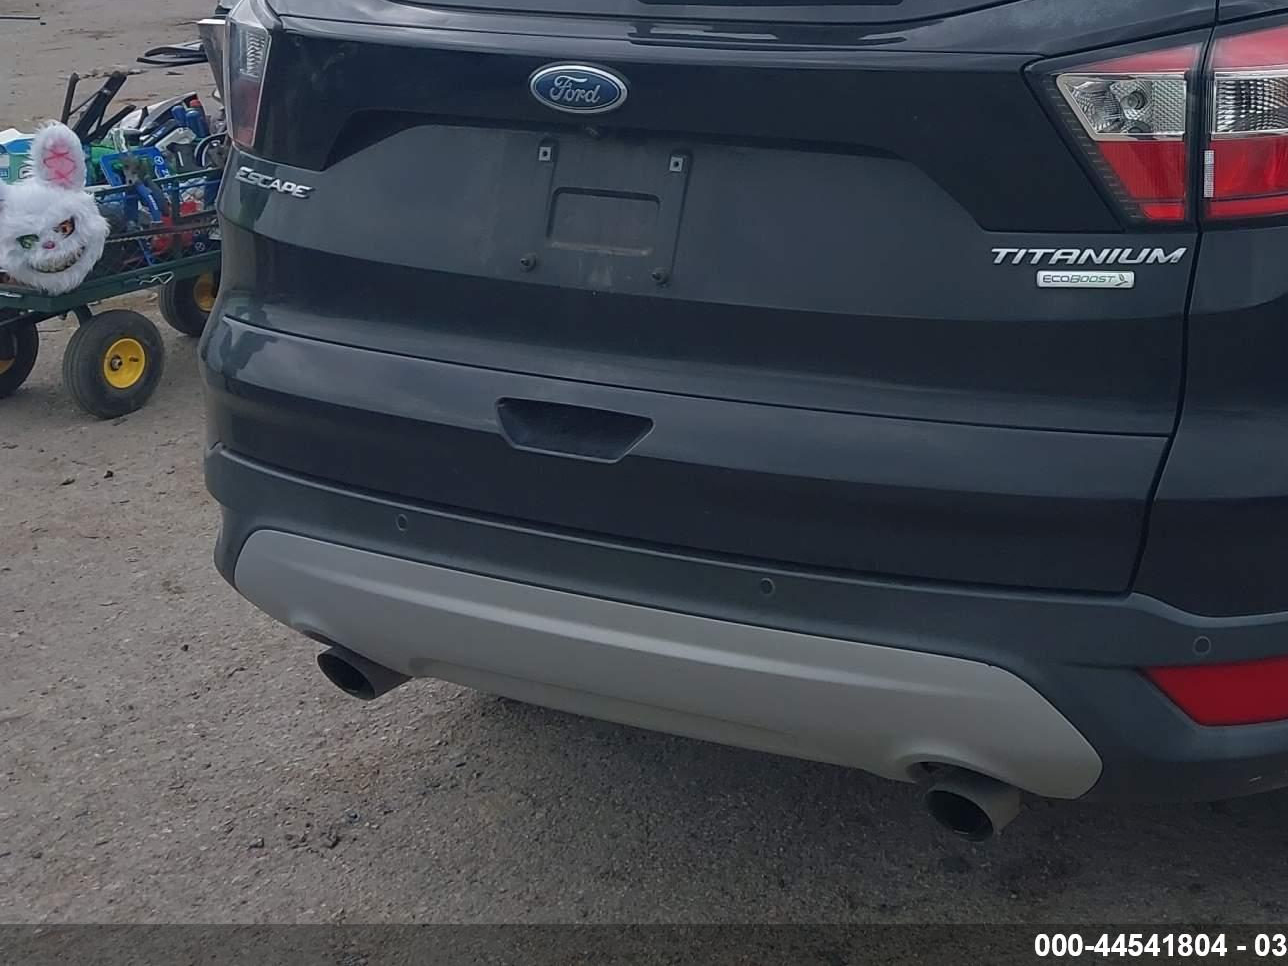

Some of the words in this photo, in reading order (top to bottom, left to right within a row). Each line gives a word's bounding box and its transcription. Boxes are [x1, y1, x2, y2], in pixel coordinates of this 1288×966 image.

[549, 75, 602, 103] Ford
[235, 166, 313, 198] ESCAPE
[991, 247, 1188, 265] TITANIUM
